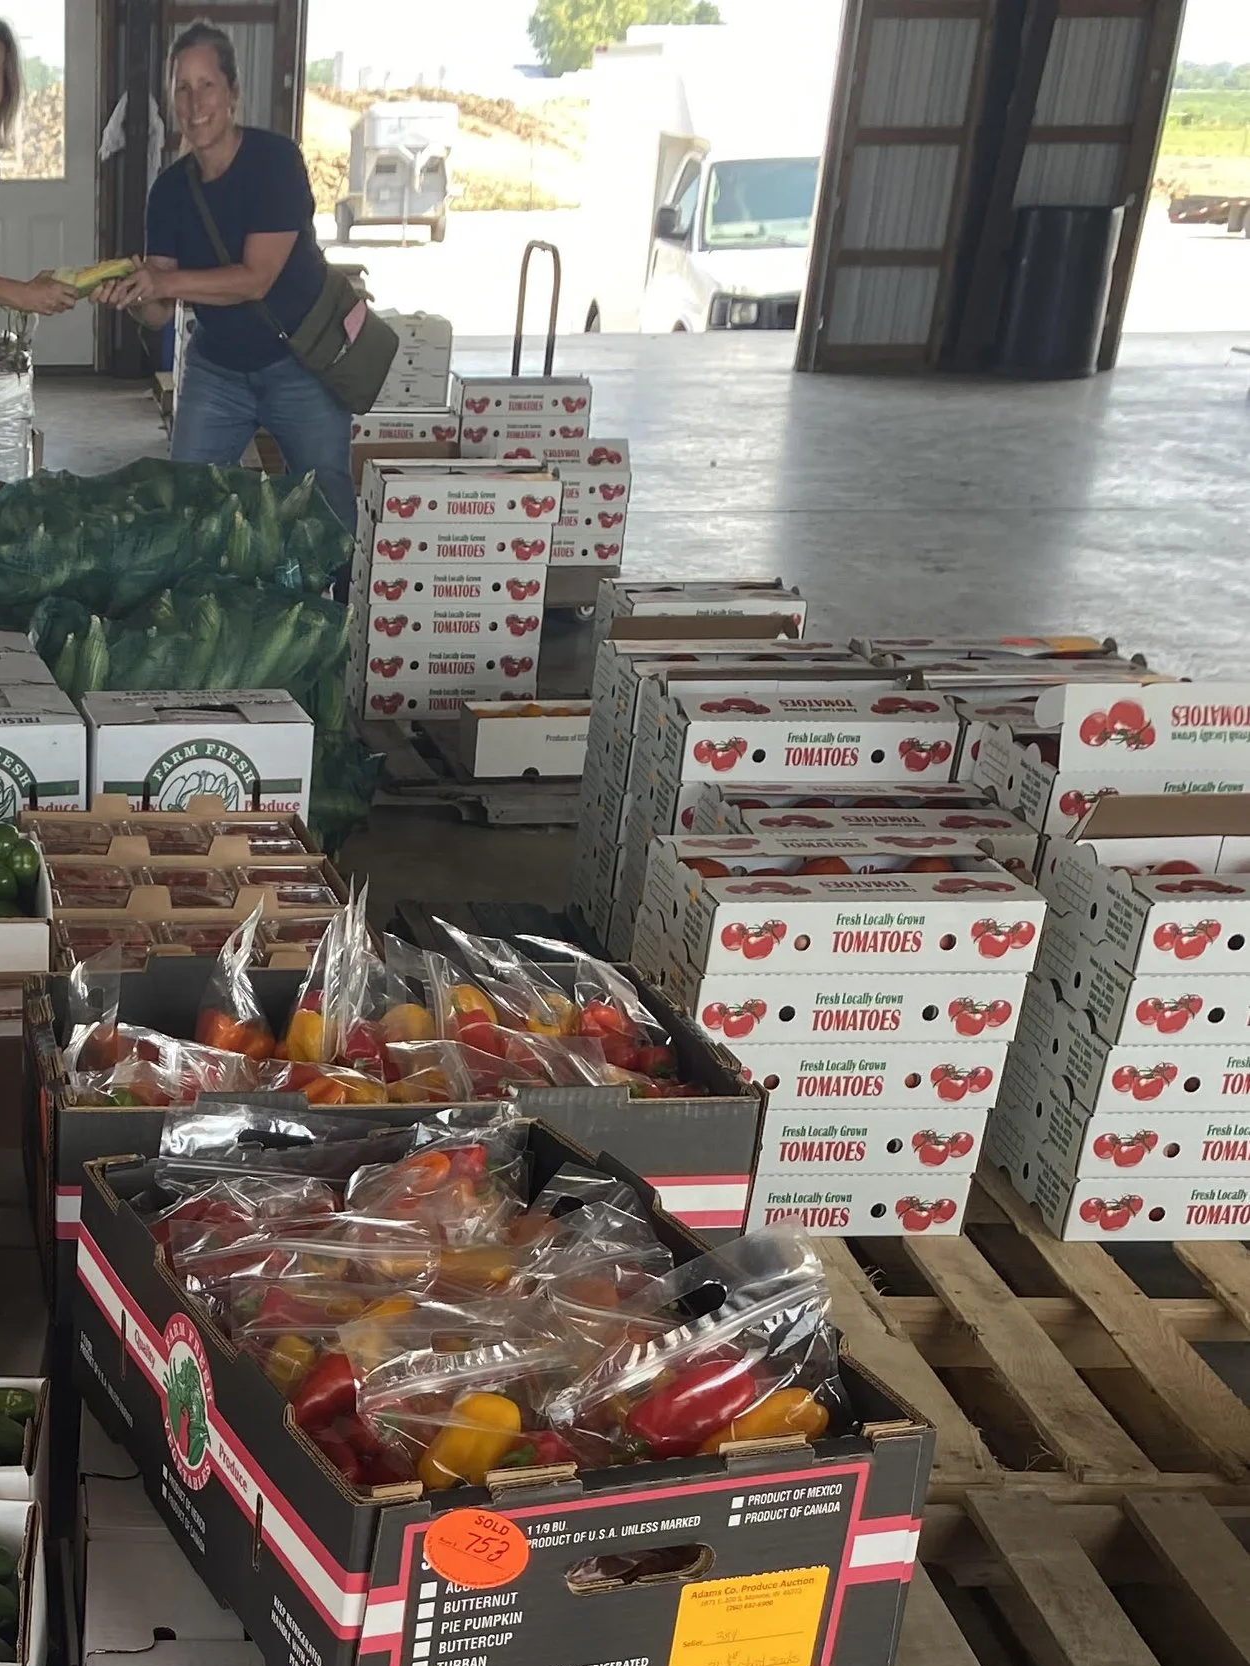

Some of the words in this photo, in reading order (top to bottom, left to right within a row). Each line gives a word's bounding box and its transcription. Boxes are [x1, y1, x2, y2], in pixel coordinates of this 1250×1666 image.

[447, 501, 495, 515] TOMATOES
[437, 544, 485, 557] TOMATOES
[433, 585, 481, 597] TOMATOES
[433, 621, 480, 634] TOMATOES
[428, 662, 475, 674] TOMATOES
[152, 745, 198, 783] FARM
[205, 742, 255, 785] FRESH
[784, 747, 859, 766] TOMATOES
[836, 913, 861, 926] Fresh
[863, 913, 895, 927] Locally
[897, 912, 926, 926] Grown
[832, 930, 923, 953] TOMATOES
[815, 993, 840, 1005] Fresh
[841, 993, 874, 1007] Locally
[875, 992, 904, 1005] Grown
[812, 1009, 902, 1032] TOMATOES
[800, 1060, 825, 1071] Fresh
[825, 1060, 857, 1073] Locally
[858, 1059, 887, 1071] Grown
[796, 1075, 884, 1097] TOMATOES
[782, 1125, 806, 1137] Fresh
[807, 1125, 839, 1139] Locally
[840, 1125, 868, 1137] Grown
[1206, 1124, 1232, 1136] Fresh
[779, 1141, 866, 1162] TOMATOES
[767, 1192, 792, 1204] Fresh
[793, 1192, 824, 1206] Locally
[824, 1191, 852, 1204] Grown
[1190, 1189, 1216, 1201] Fresh
[1216, 1188, 1248, 1203] Locally
[164, 1414, 211, 1491] VEGETABLES
[747, 1490, 792, 1507] PRODUCT
[793, 1487, 806, 1500] OF
[806, 1483, 843, 1499] MEXICO
[744, 1508, 789, 1525] PRODUCT
[790, 1506, 803, 1518] OF
[803, 1501, 841, 1517] CANADA
[474, 1514, 509, 1536] SOLD
[527, 1525, 532, 1536] 1
[573, 1532, 586, 1544] OF
[621, 1522, 659, 1538] UNLESS
[660, 1515, 701, 1532] MARKED
[464, 1532, 510, 1563] 753
[443, 1592, 518, 1615] BUTTERNUT
[440, 1621, 462, 1635] PIE
[464, 1612, 523, 1632] PUMPKIN
[438, 1632, 513, 1655] BUTTERCUP
